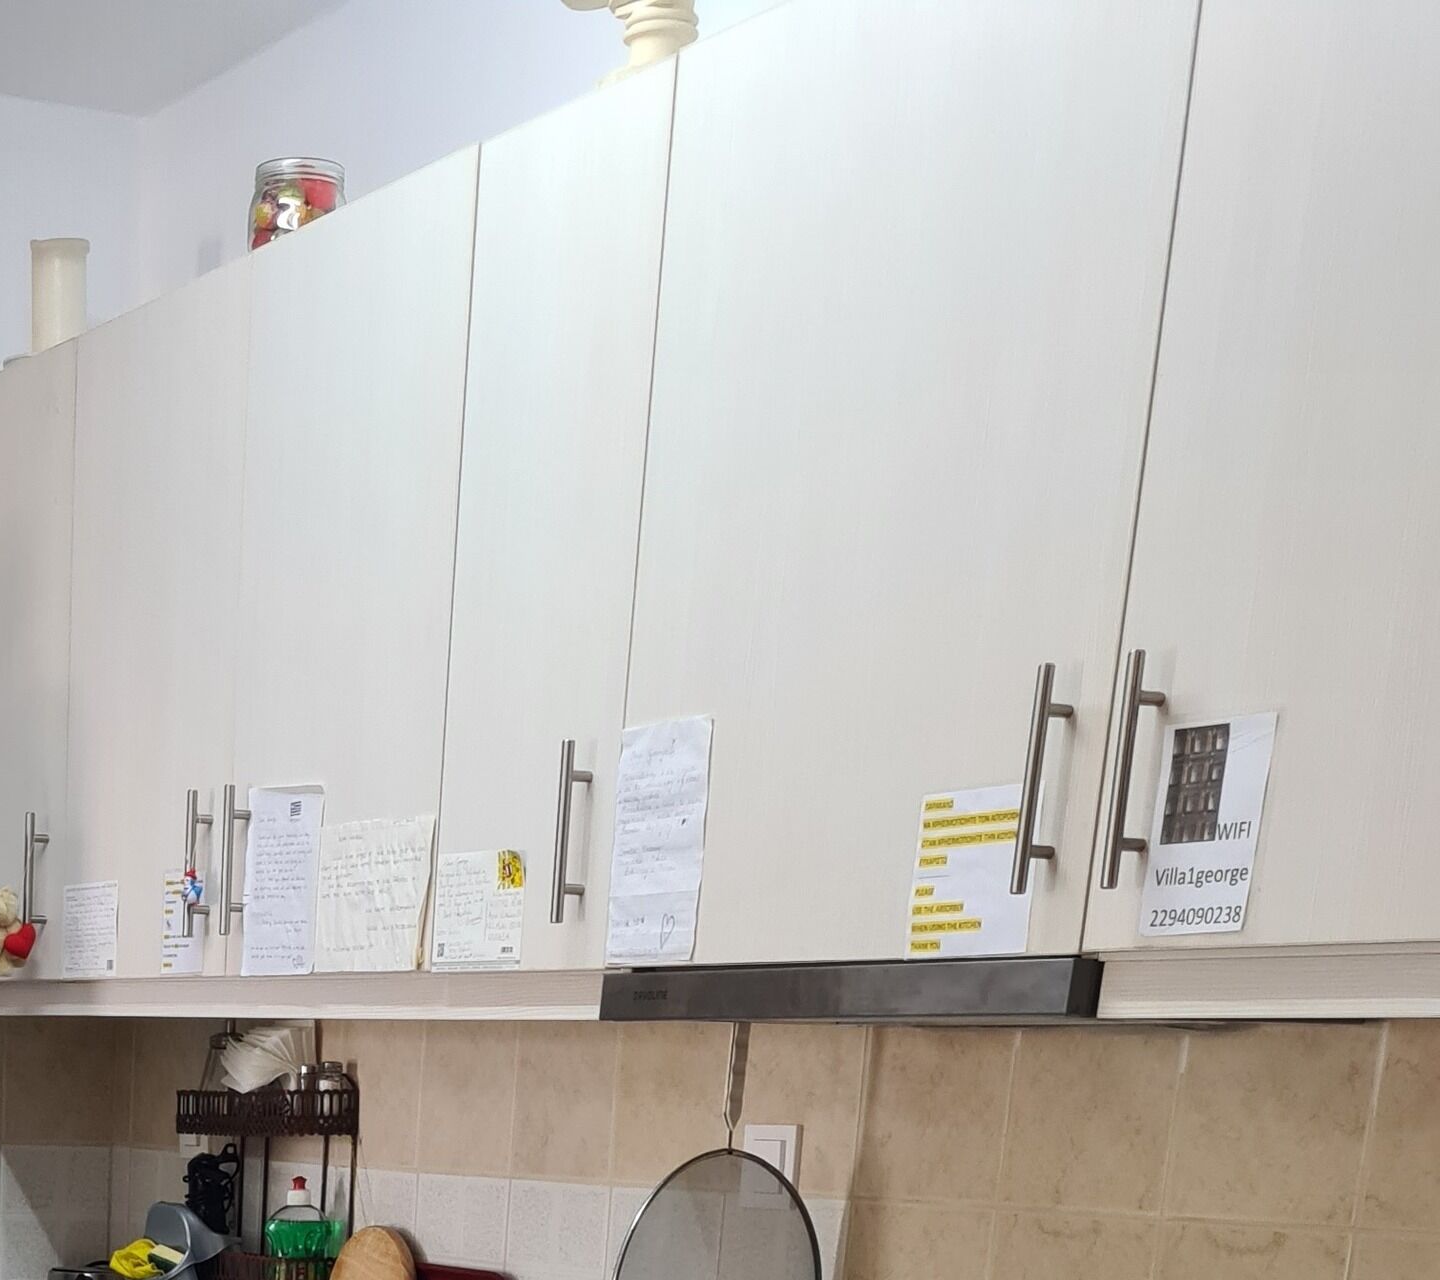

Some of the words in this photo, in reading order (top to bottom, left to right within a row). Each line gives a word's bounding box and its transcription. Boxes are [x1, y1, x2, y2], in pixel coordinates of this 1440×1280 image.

[1217, 821, 1252, 841] WIFI
[1155, 866, 1249, 889] Villa1george
[1150, 905, 1243, 927] 2294090238
